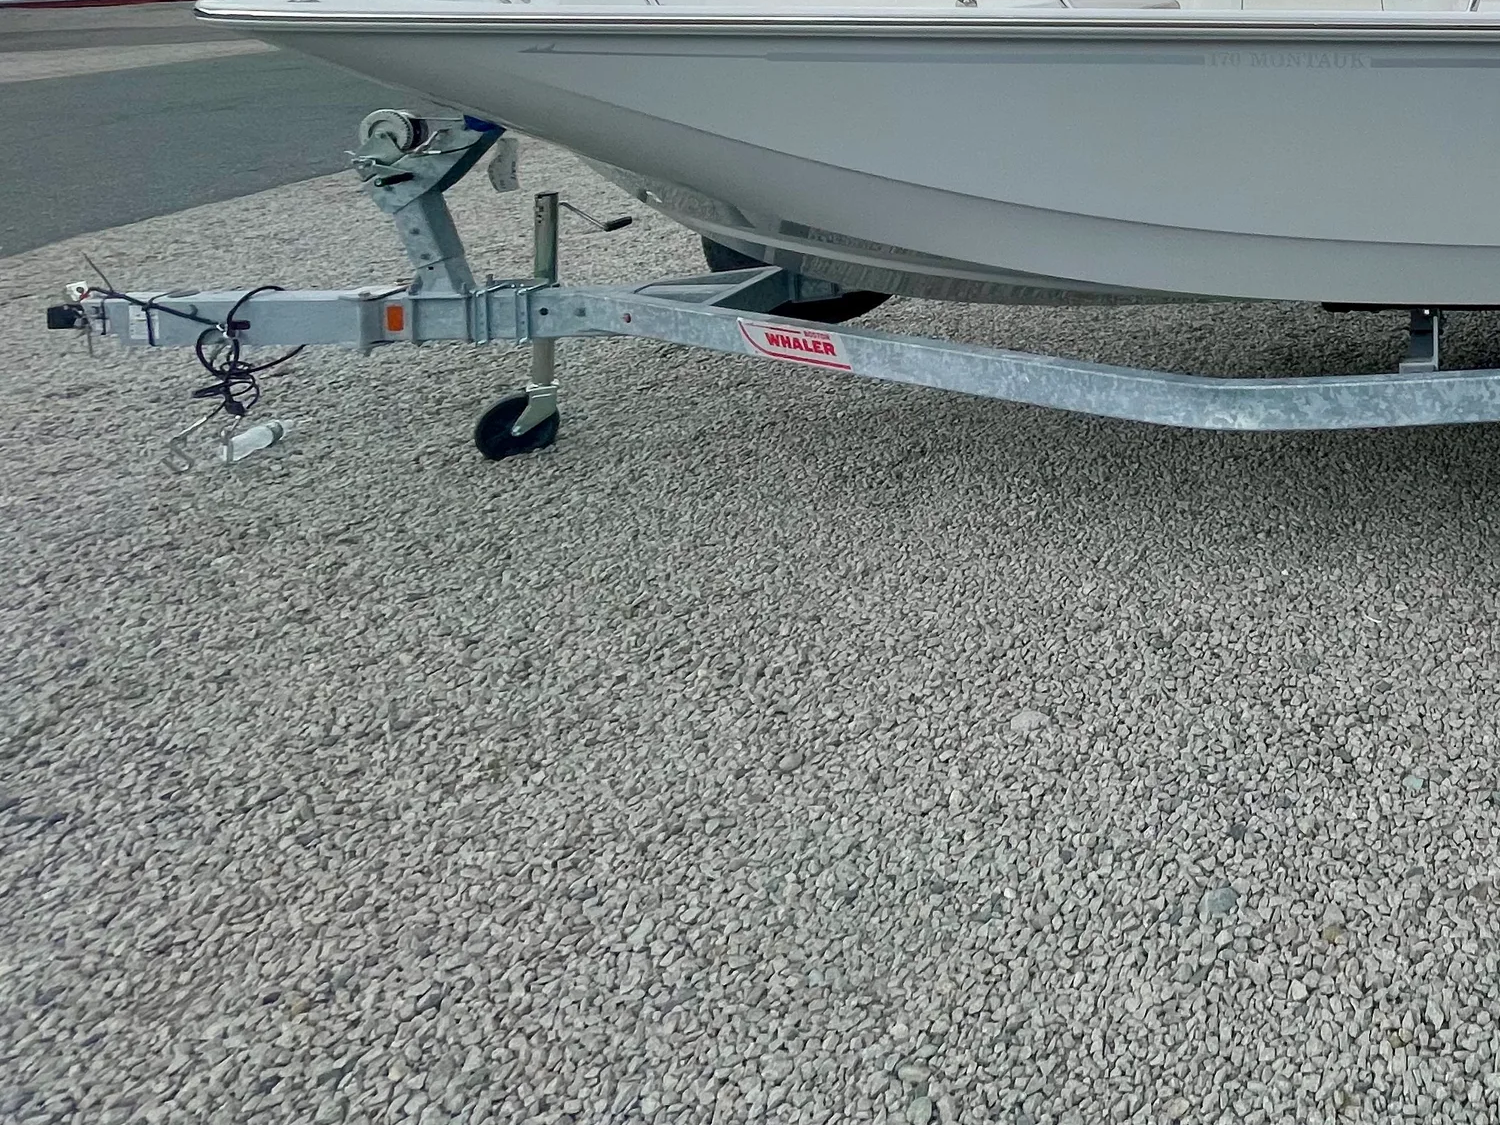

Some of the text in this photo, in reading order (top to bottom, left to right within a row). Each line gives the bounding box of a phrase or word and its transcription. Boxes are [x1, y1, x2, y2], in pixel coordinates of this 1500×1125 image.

[1207, 52, 1368, 69] 170 MONTAUK
[764, 332, 838, 356] WHALER
